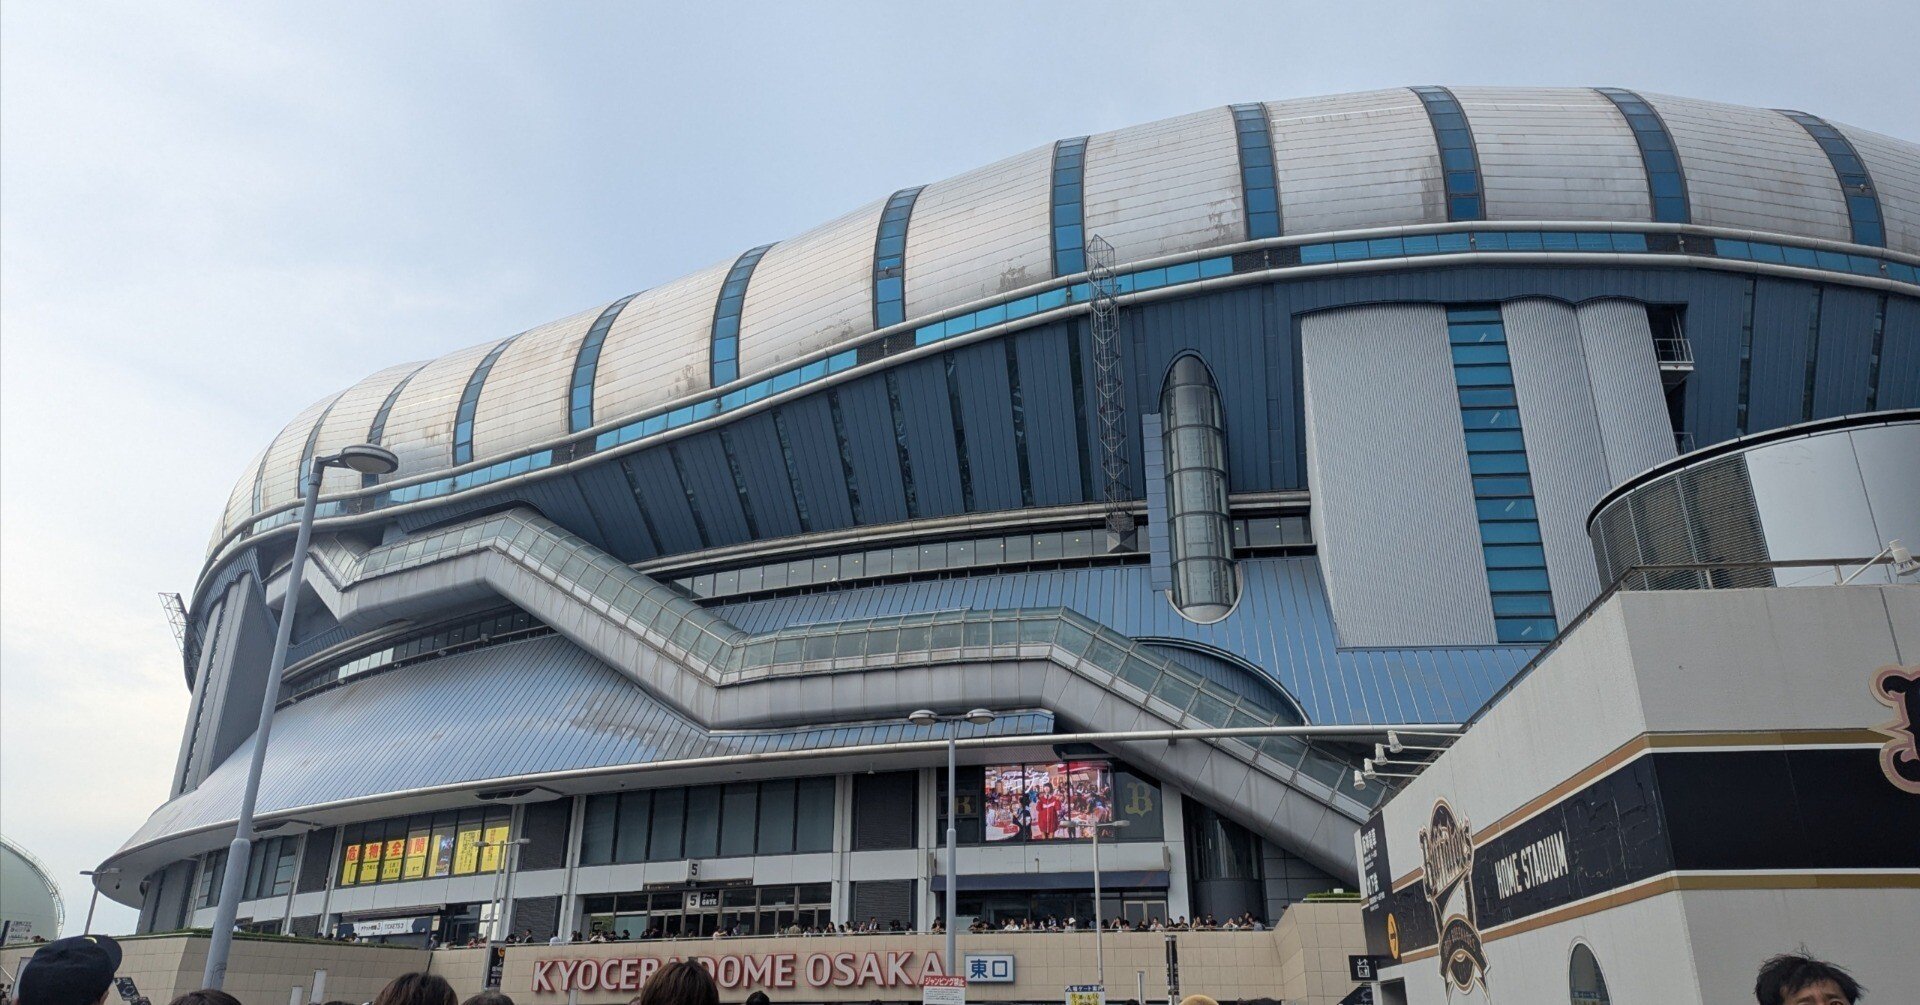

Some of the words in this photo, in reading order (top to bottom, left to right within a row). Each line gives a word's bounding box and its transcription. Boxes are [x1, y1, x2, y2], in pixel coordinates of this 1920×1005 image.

[1125, 782, 1153, 817] B
[691, 863, 698, 876] 5
[1495, 852, 1522, 899] HOME
[1520, 830, 1569, 889] STADIUM
[689, 895, 698, 906] 5
[531, 956, 680, 992] KYOCER
[805, 952, 946, 987] OSAKA
[970, 959, 1008, 978] 東口
